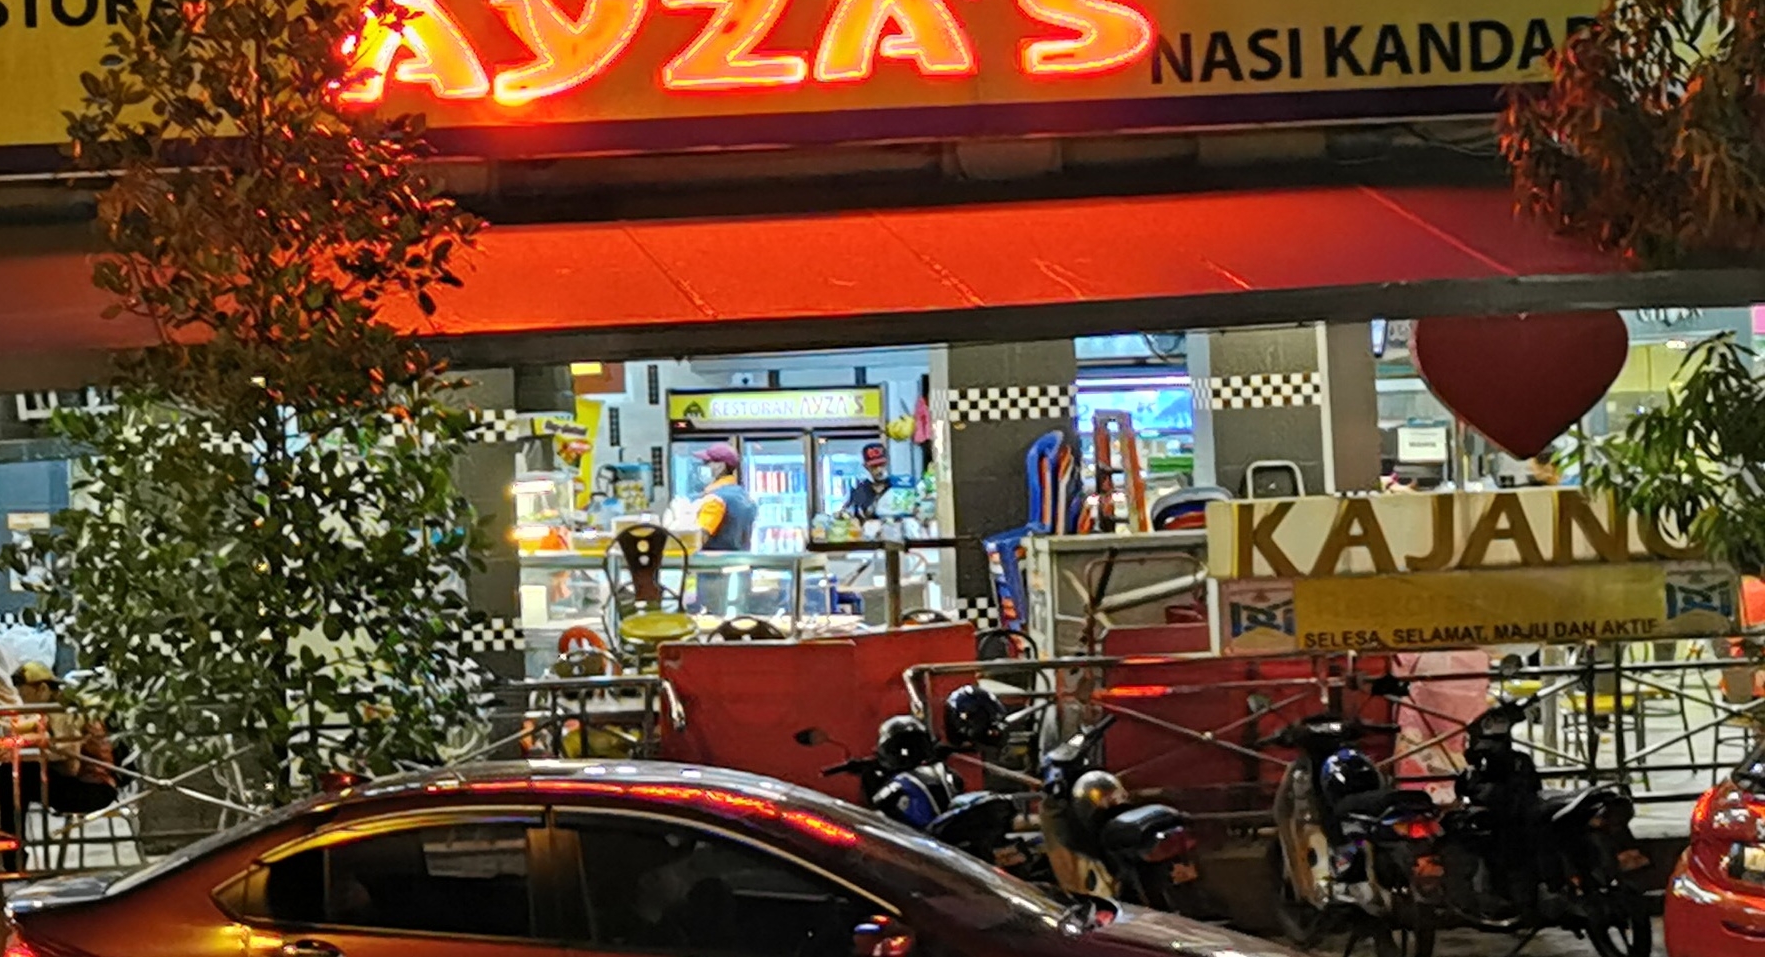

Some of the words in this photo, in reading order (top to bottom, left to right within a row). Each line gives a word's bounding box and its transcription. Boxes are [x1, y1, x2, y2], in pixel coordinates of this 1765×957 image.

[1152, 28, 1302, 84] NASI
[711, 400, 795, 416] RESTORAN
[799, 394, 865, 415] AYZA'S
[1494, 622, 1549, 641] MAJU
[1554, 620, 1597, 638] DAN
[1601, 617, 1659, 636] AKTIF
